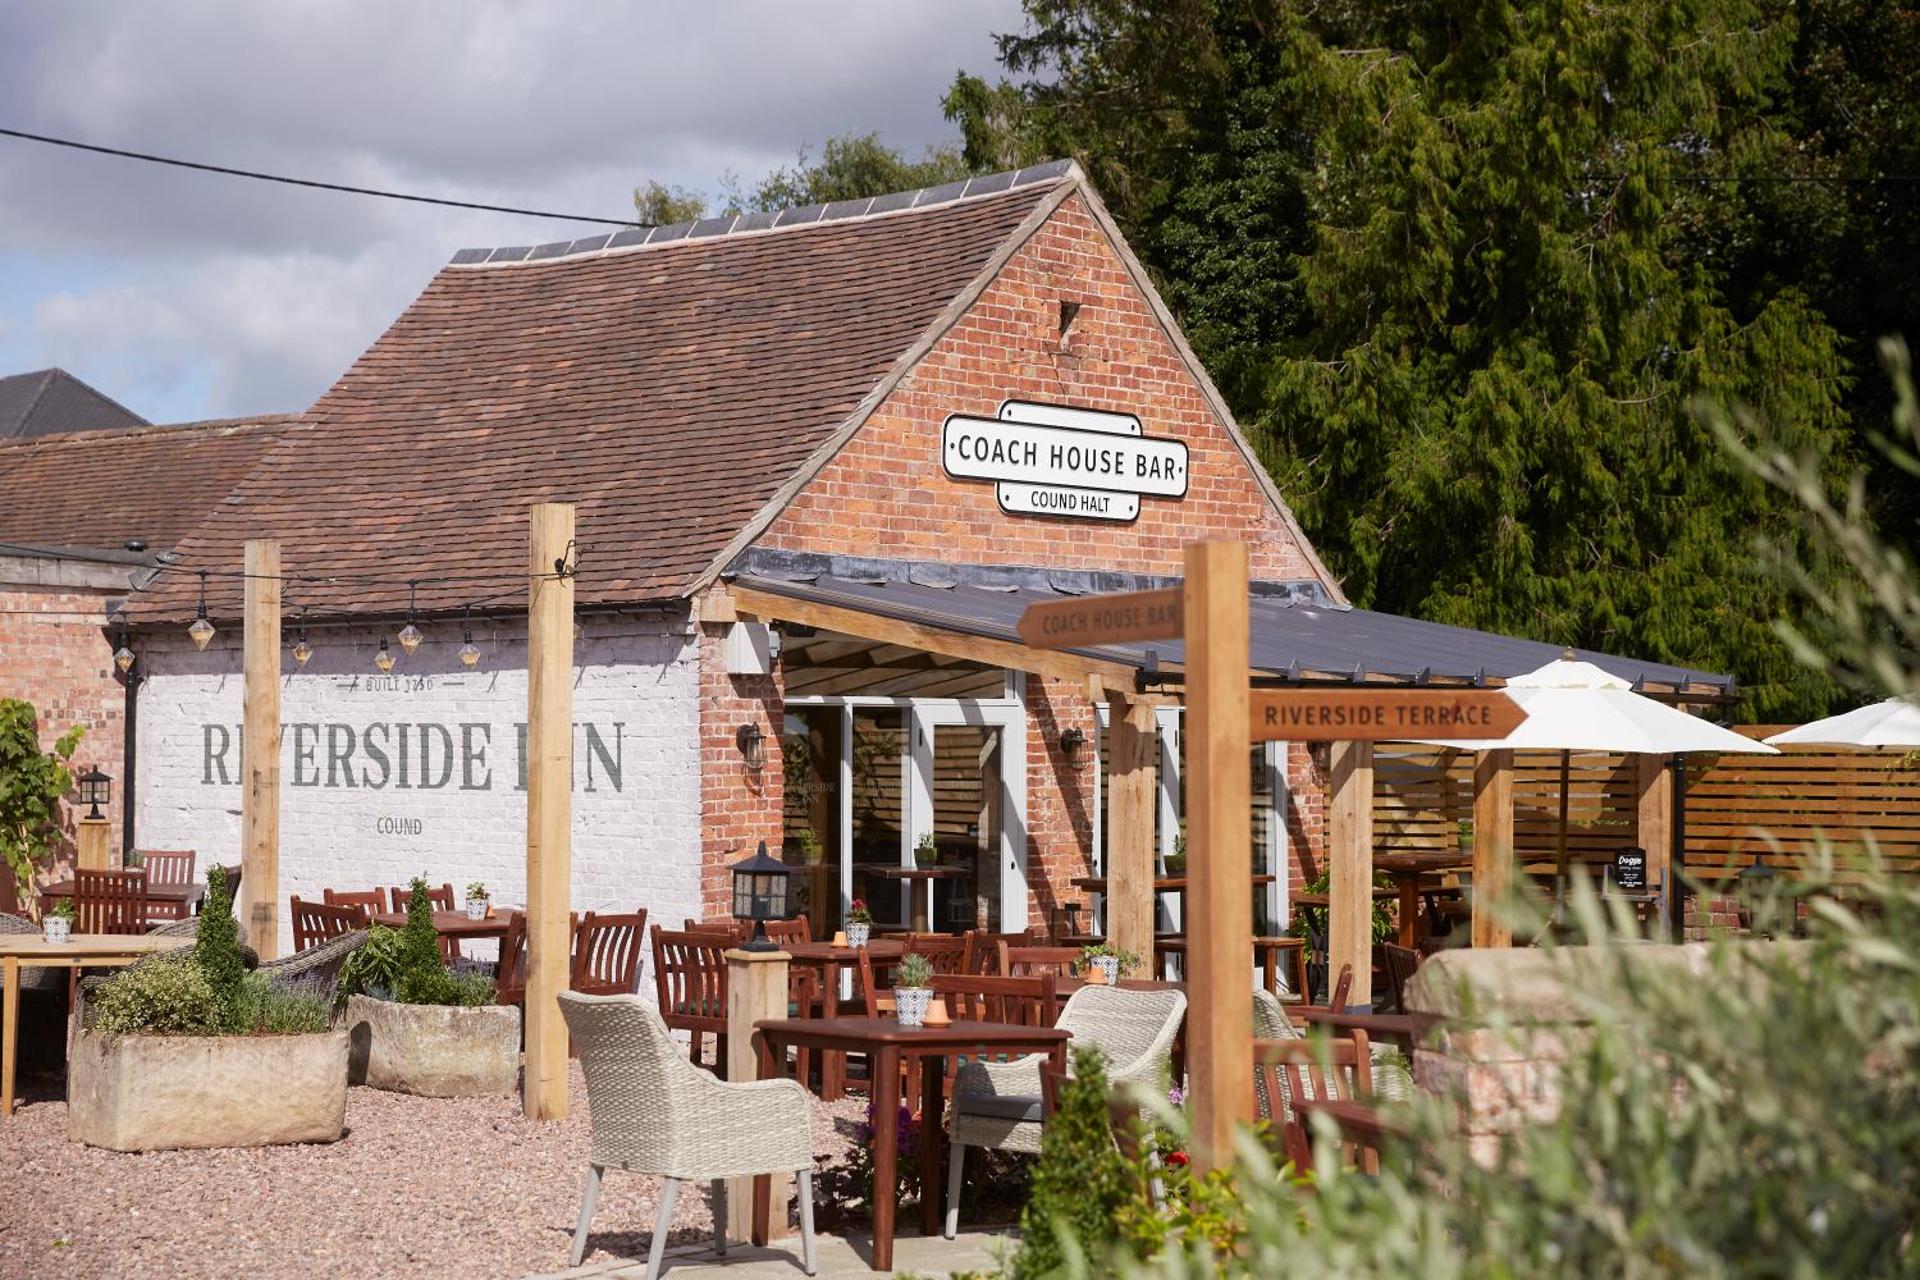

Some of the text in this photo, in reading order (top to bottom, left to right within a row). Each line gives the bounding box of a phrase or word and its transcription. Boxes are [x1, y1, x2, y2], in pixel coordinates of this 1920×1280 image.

[958, 434, 1175, 480] COACH HOUSE BAR
[1031, 490, 1110, 513] COUND HALT
[1042, 603, 1179, 635] COACH HOUSE BAR
[365, 678, 400, 692] BUILT
[1264, 705, 1492, 726] RIVERSIDE TERRACE
[200, 721, 626, 793] RIERSIDE IN
[376, 817, 422, 836] COUND
